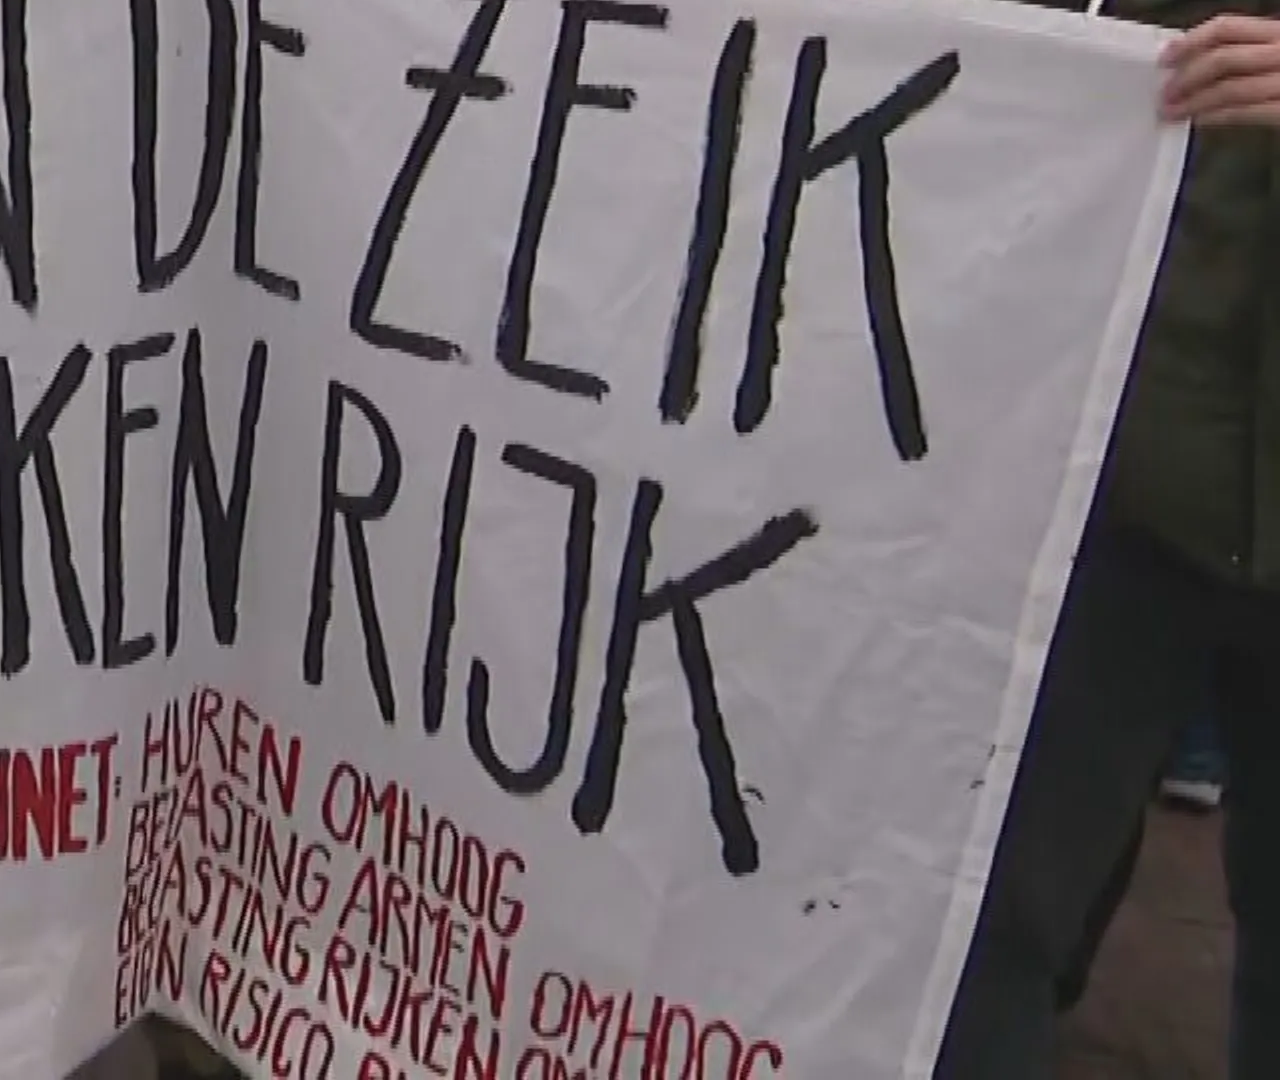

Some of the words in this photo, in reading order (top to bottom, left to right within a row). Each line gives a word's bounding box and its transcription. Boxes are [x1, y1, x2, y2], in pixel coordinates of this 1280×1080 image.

[302, 380, 820, 877] RIJK
[124, 766, 332, 914] BELASTING
[337, 856, 511, 1019] ARMEN
[142, 684, 301, 817] HUREN
[321, 761, 525, 938] OMHOOG
[200, 948, 335, 1080] RISICO
